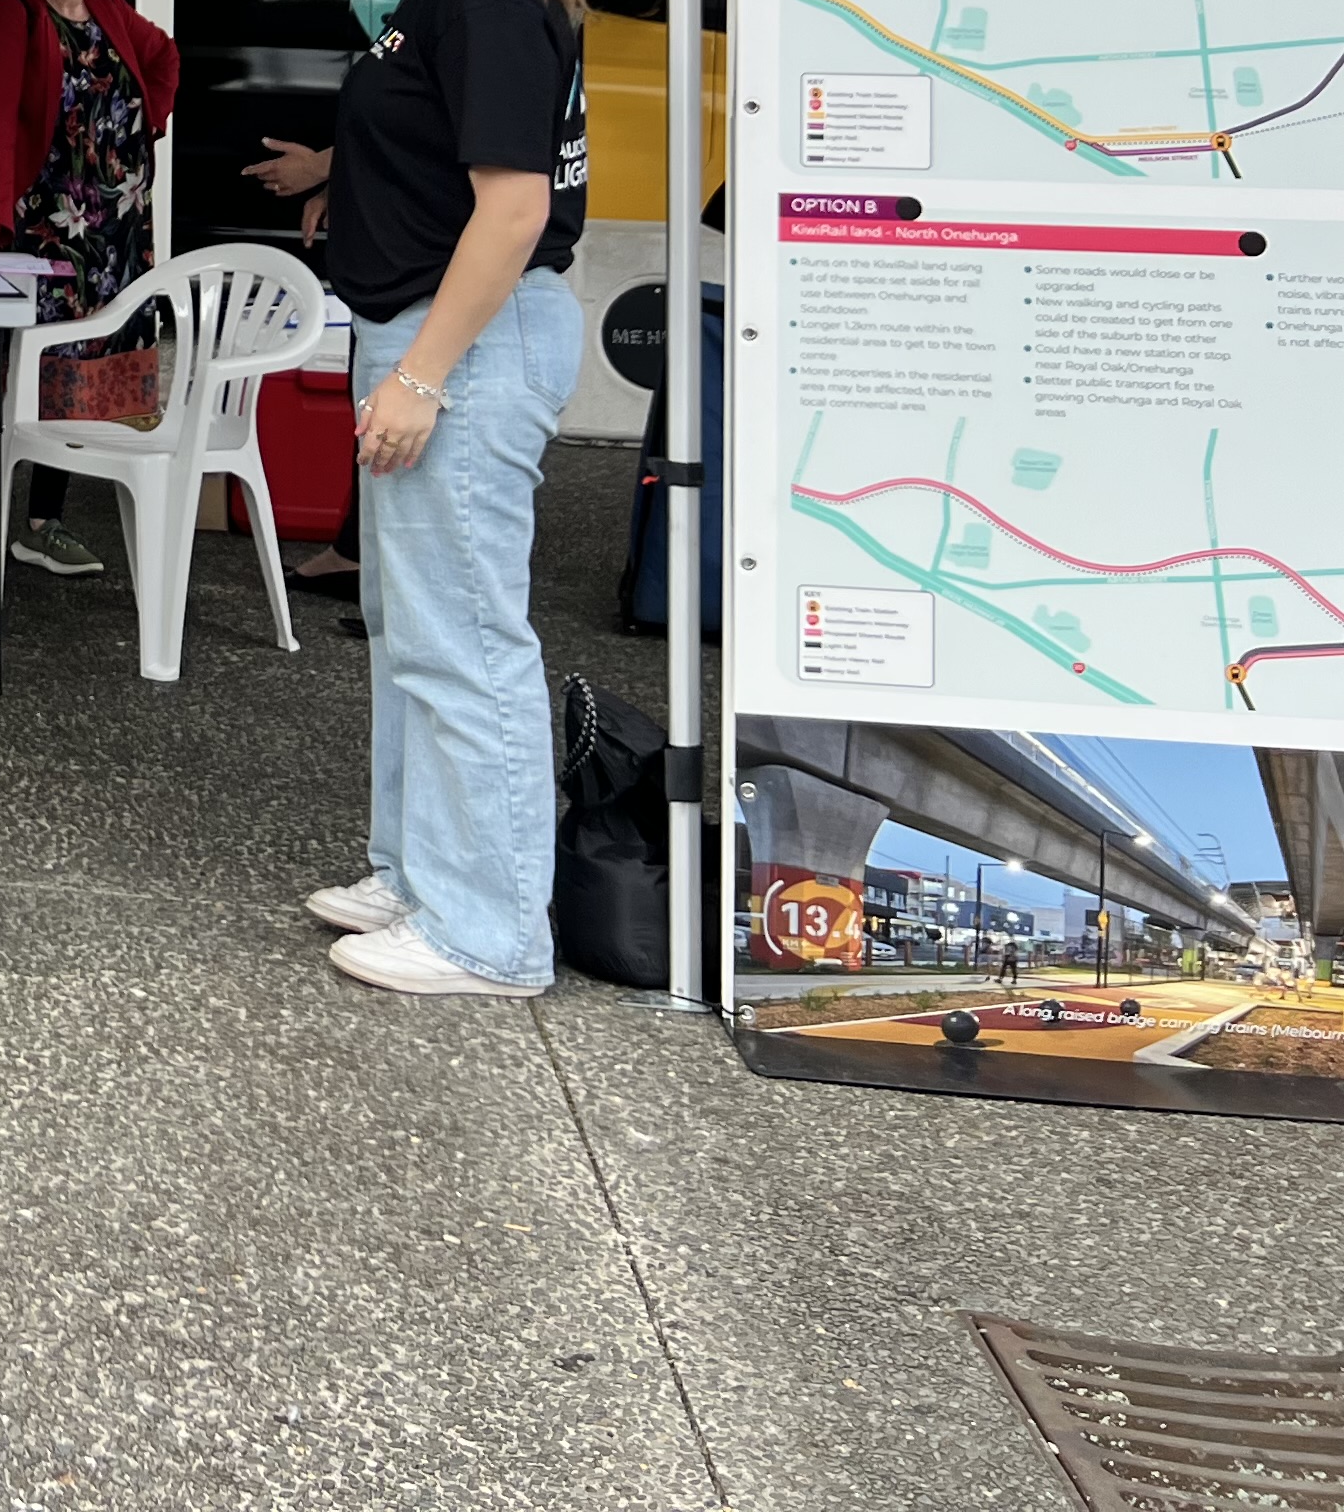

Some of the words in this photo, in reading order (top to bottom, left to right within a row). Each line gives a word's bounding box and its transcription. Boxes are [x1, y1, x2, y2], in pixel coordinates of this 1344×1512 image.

[791, 197, 861, 214] OPTION
[864, 199, 877, 214] B
[791, 223, 848, 236] KiwiRail
[850, 224, 882, 238] land
[895, 226, 938, 239] North
[940, 228, 1018, 245] Onehunga
[1002, 1004, 1017, 1015] A
[1018, 1004, 1053, 1020] long,
[1058, 1008, 1105, 1023] raised
[1107, 1011, 1157, 1029] bridge
[1159, 1017, 1221, 1034] carrying
[1224, 1021, 1268, 1036] trains
